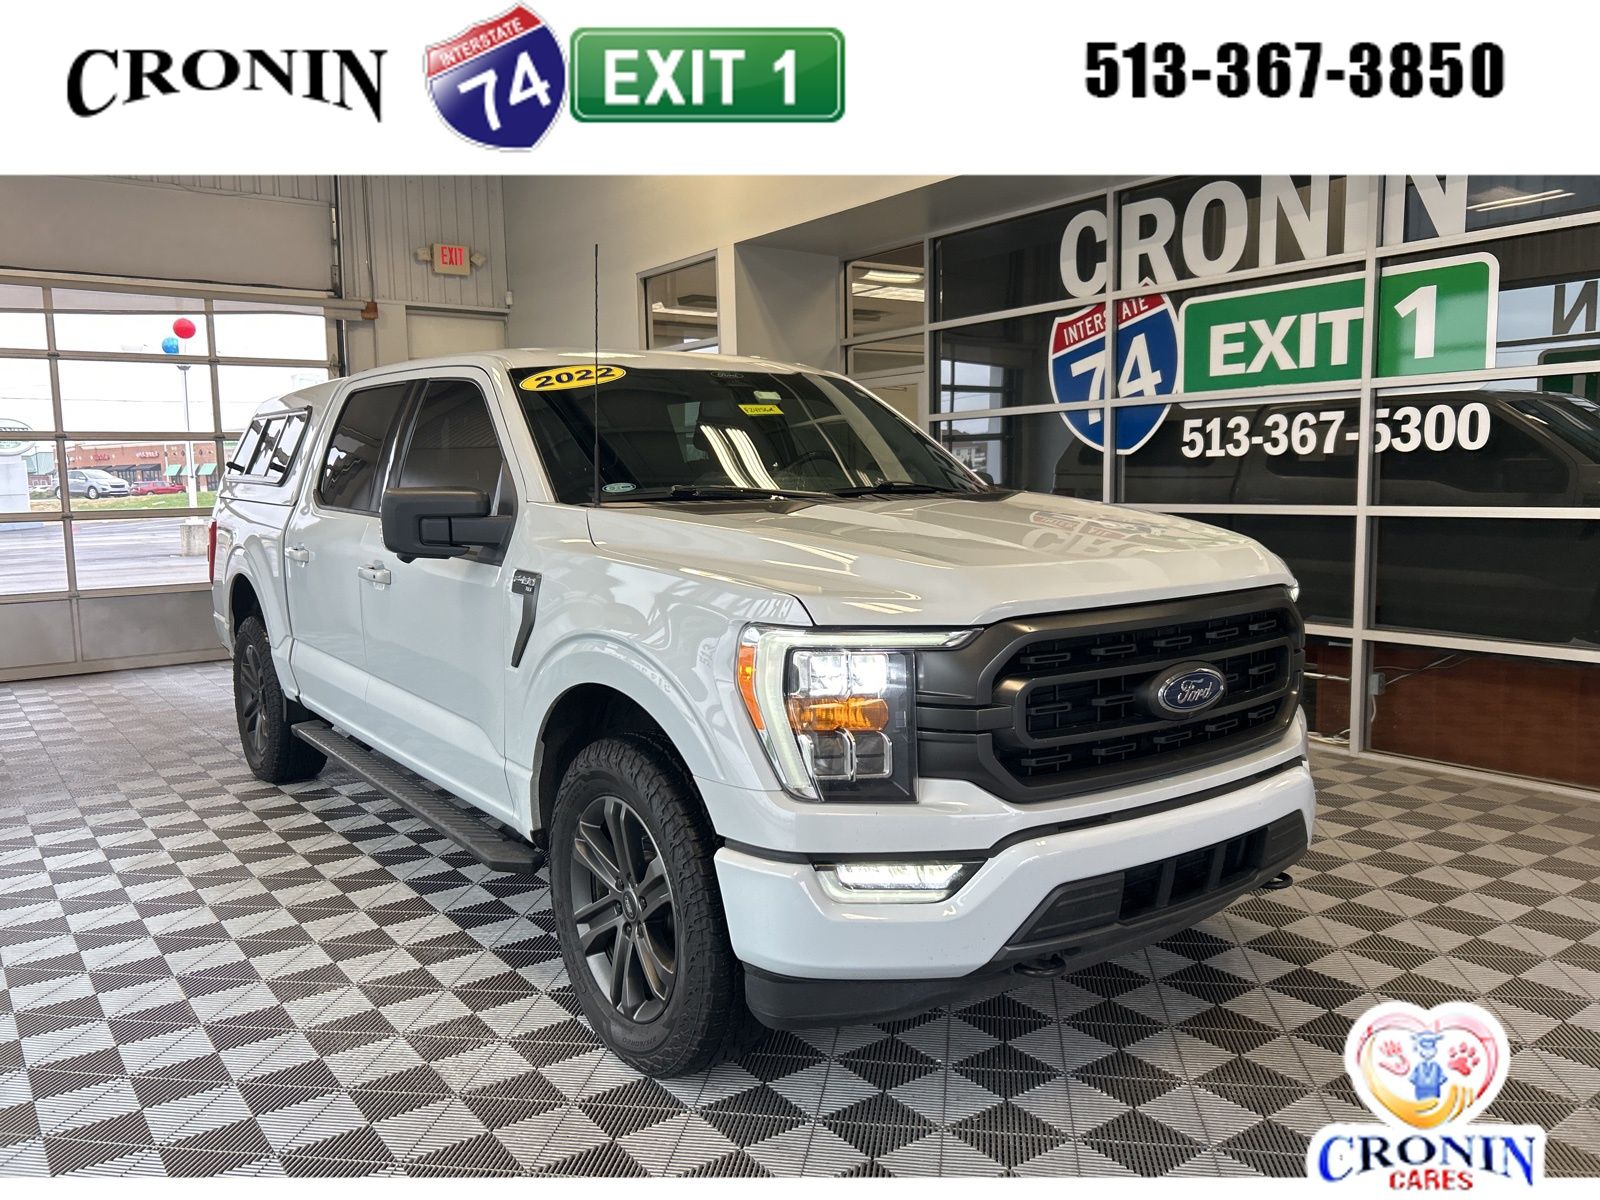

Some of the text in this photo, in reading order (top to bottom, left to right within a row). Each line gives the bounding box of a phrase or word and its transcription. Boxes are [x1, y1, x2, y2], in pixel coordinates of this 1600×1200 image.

[441, 246, 464, 266] EXIT
[1060, 175, 1467, 298] CRONIN
[1209, 285, 1438, 378] EXIT 1
[534, 367, 616, 388] 2022
[1070, 333, 1162, 425] 74
[1181, 403, 1491, 458] 513-367-5300
[1177, 678, 1214, 704] Ford
